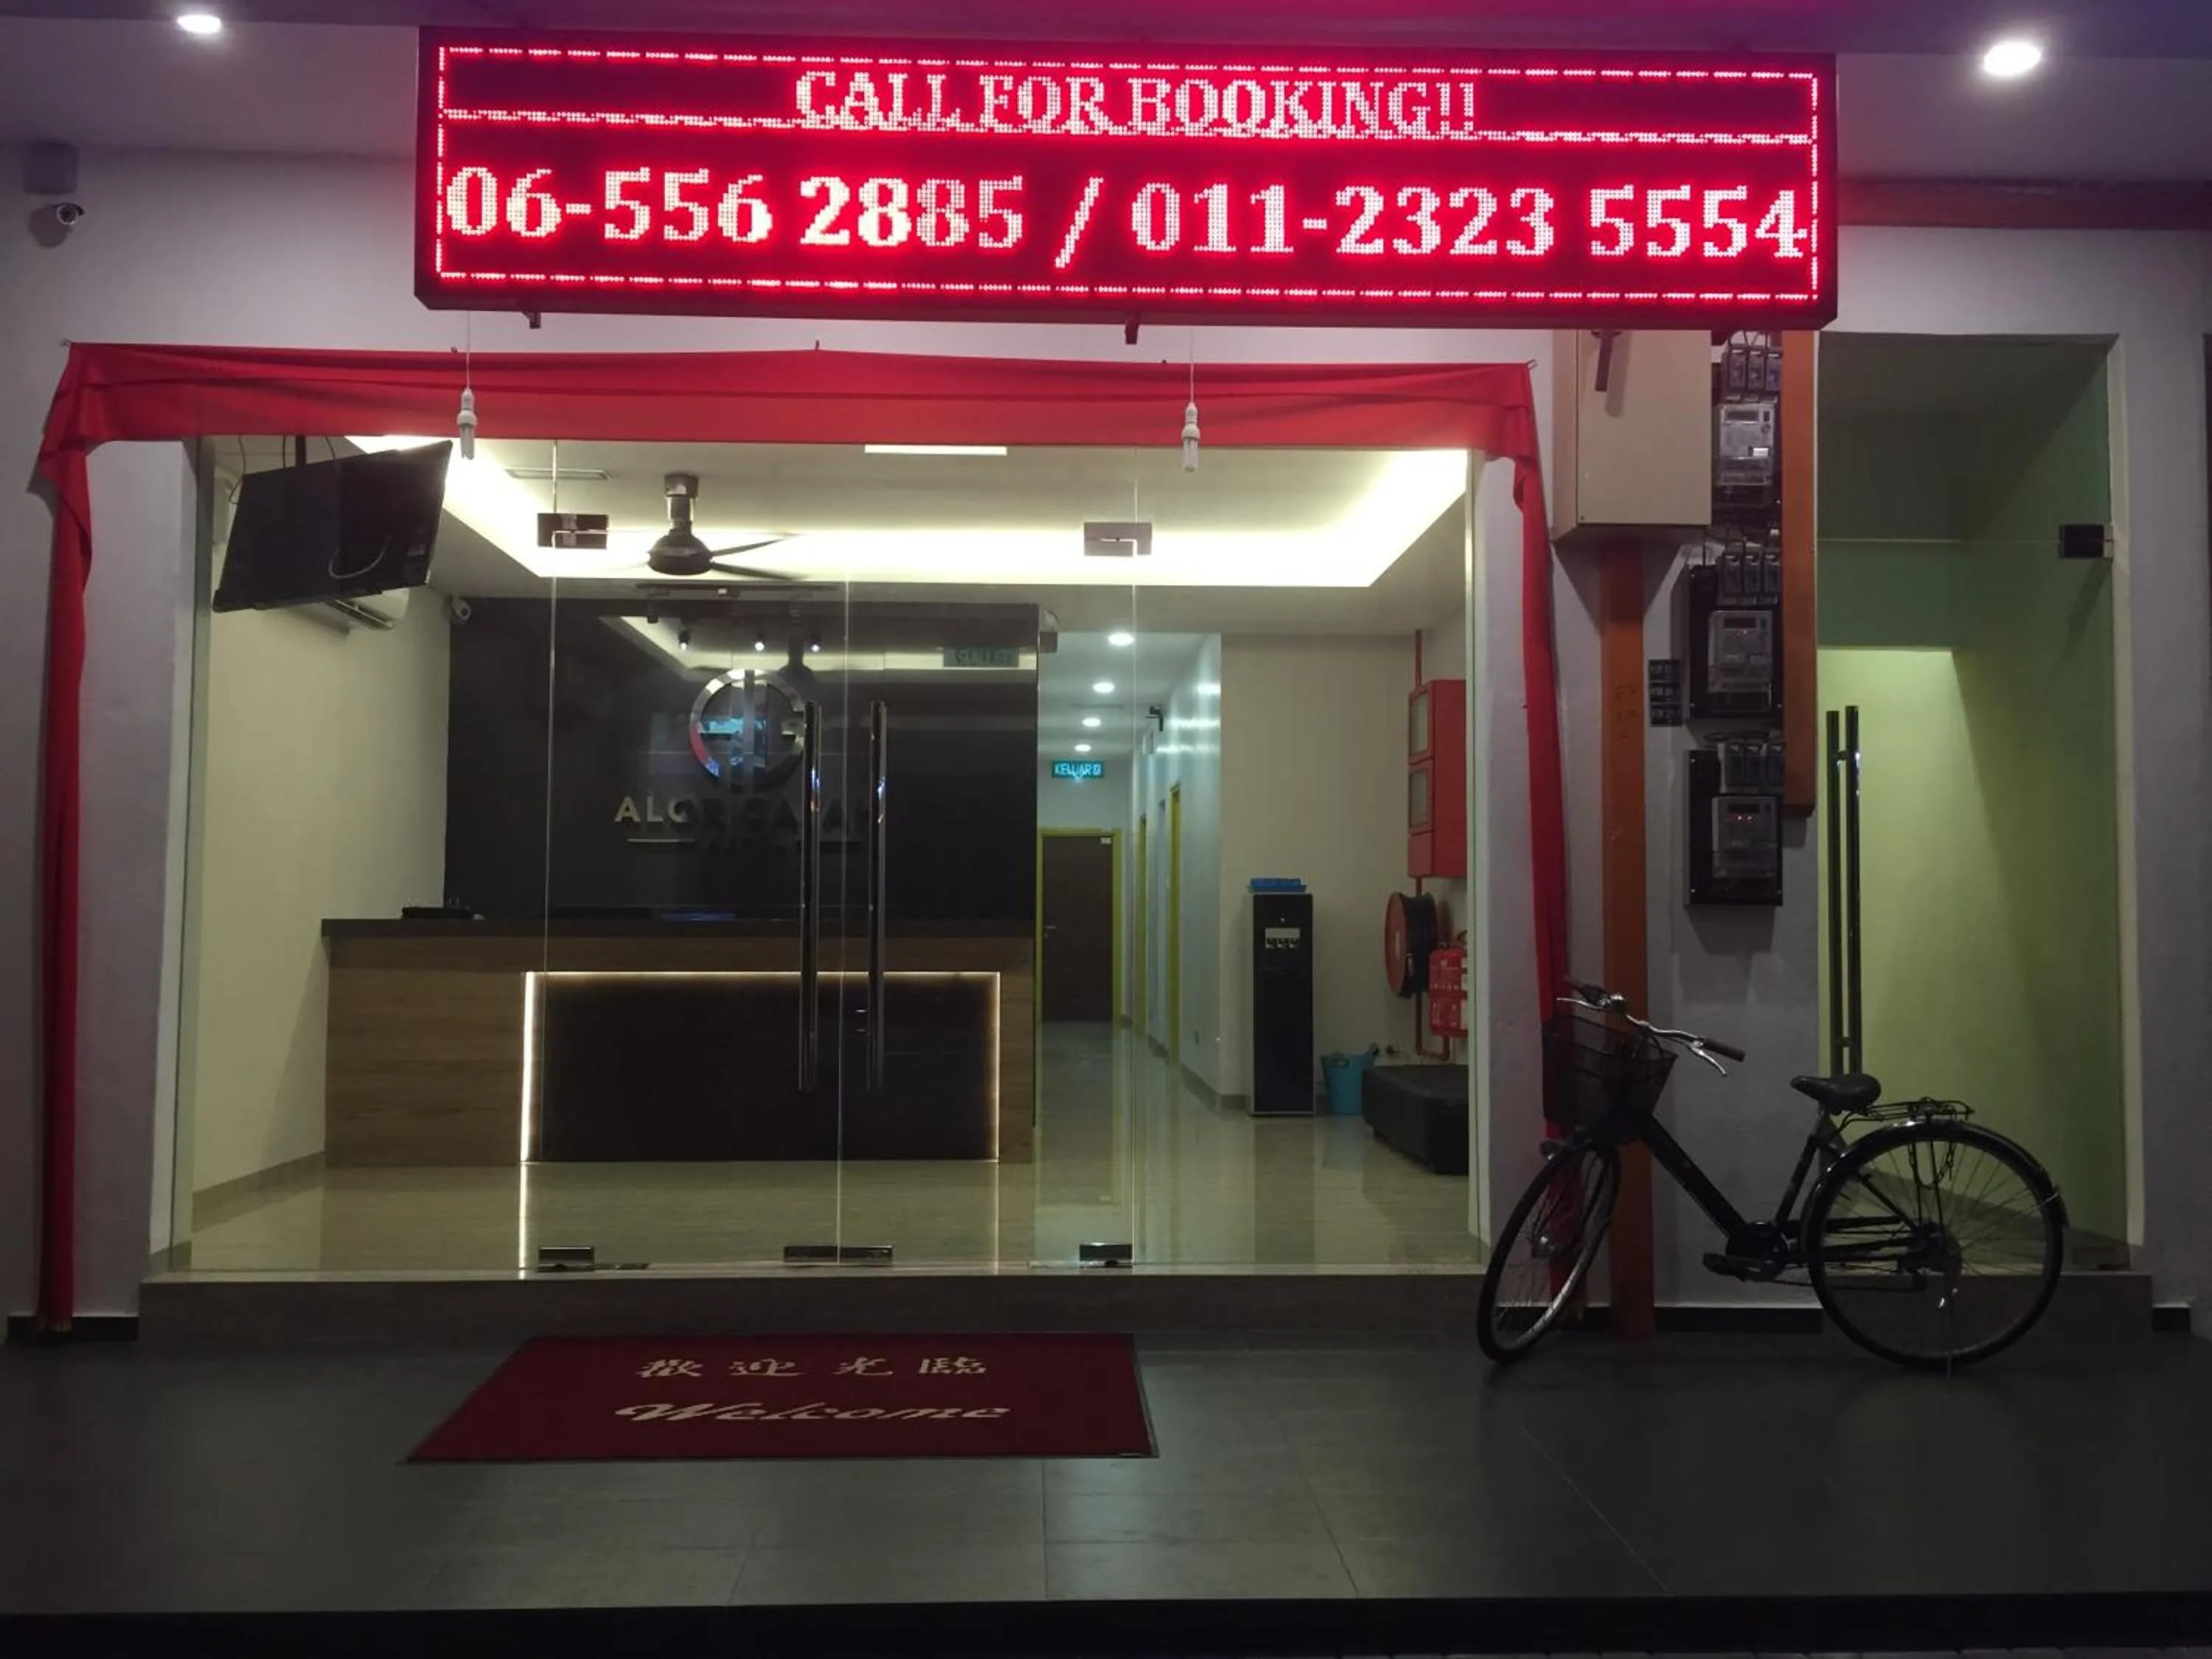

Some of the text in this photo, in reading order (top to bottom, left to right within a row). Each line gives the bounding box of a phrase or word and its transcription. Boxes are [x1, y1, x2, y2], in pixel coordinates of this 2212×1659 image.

[796, 71, 1474, 140] CALL FOR BOOKING!!
[445, 167, 1807, 268] 06-556 2885 / 011-2323 5554
[613, 1402, 1011, 1422] Welcome
